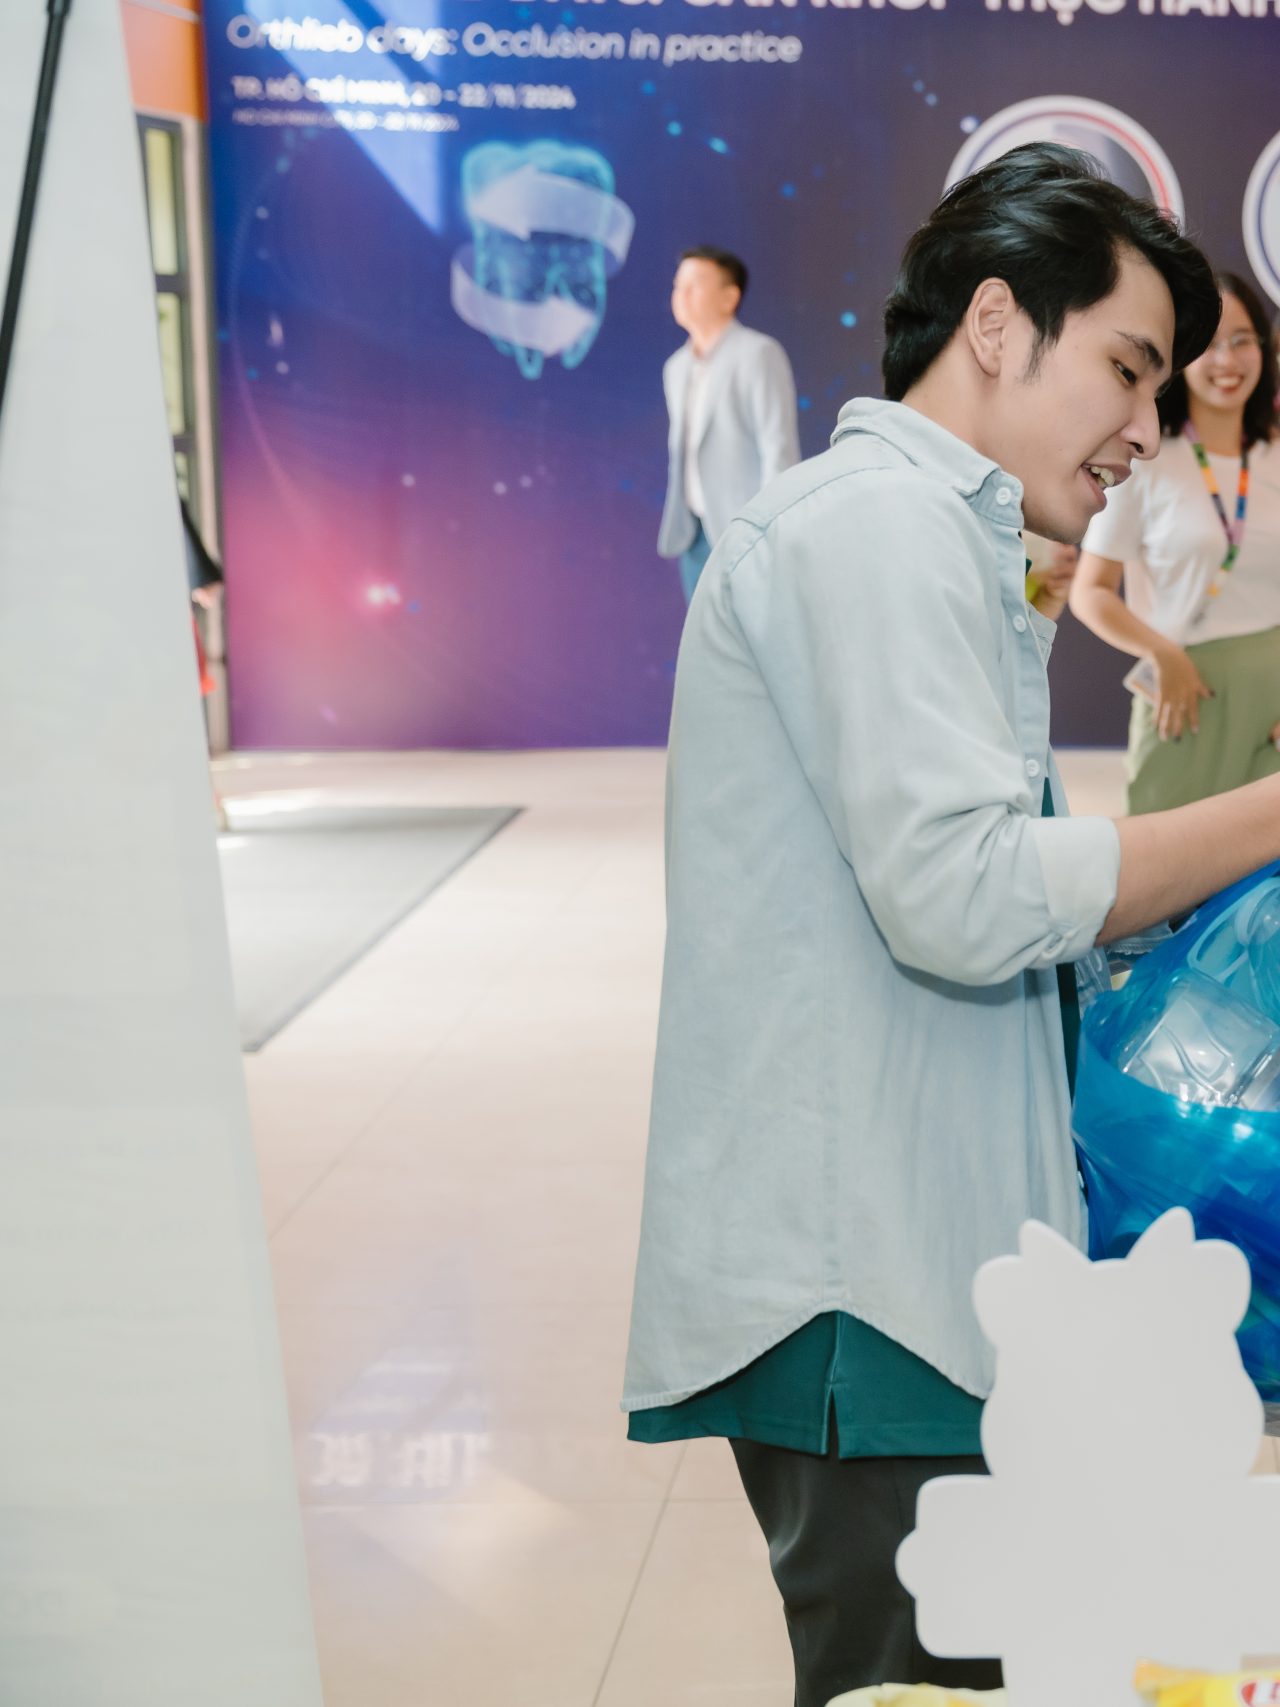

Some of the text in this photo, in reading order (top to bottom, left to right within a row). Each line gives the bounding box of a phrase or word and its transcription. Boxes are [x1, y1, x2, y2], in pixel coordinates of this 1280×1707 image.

[462, 21, 625, 59] Occlusion
[629, 27, 661, 60] in
[663, 28, 802, 68] practice
